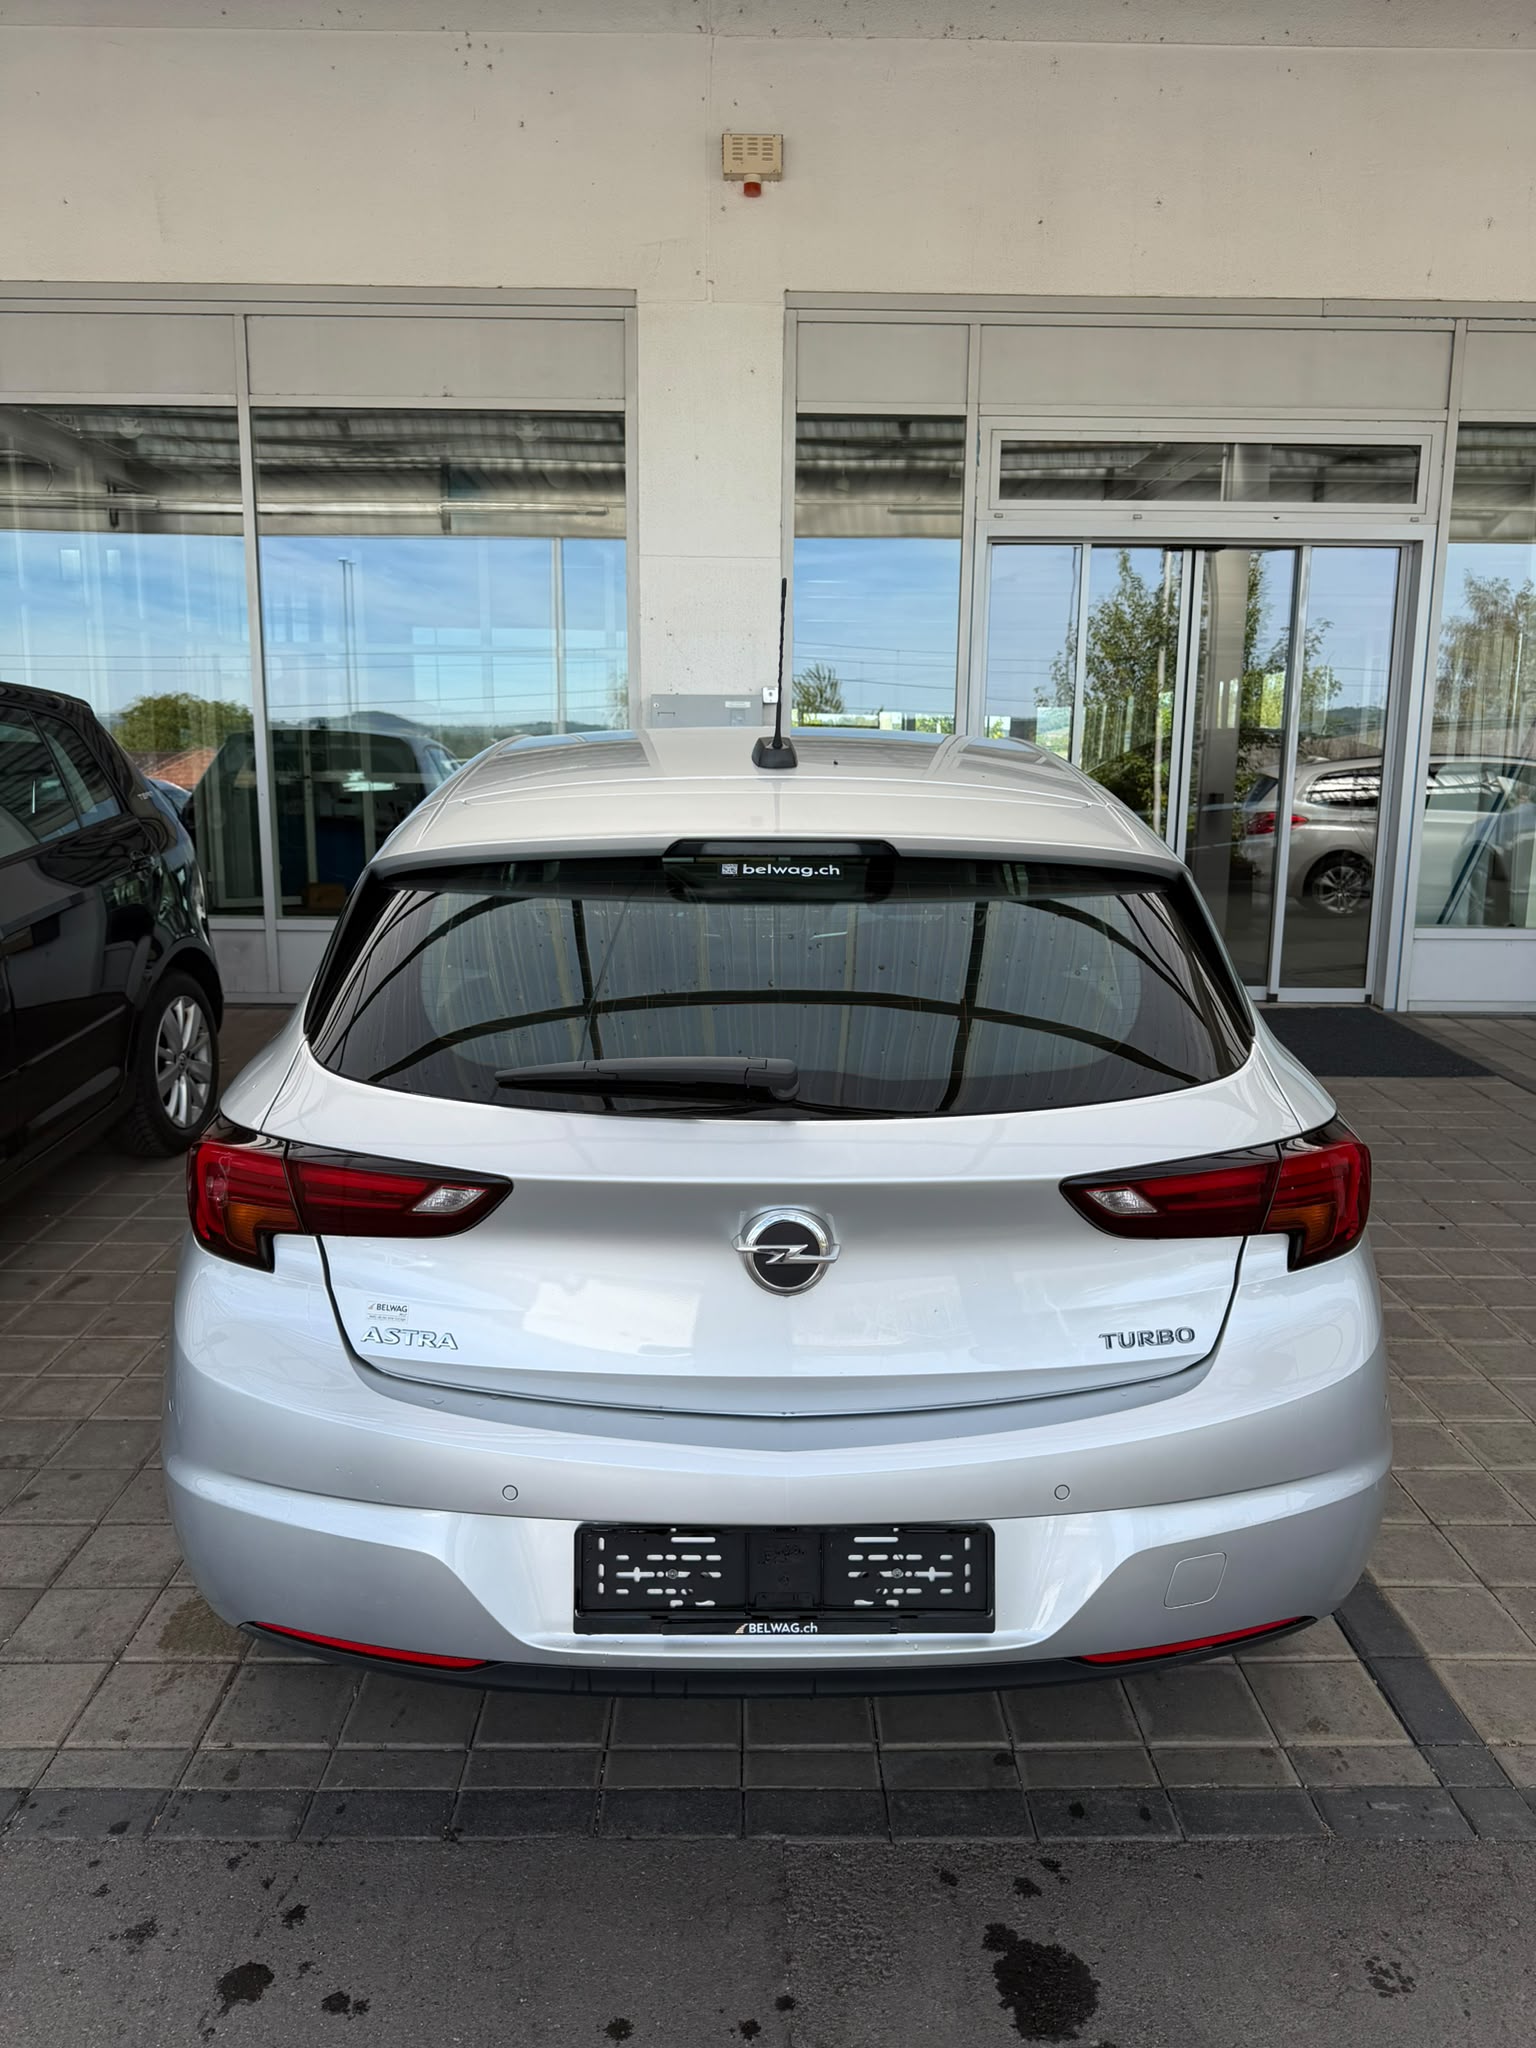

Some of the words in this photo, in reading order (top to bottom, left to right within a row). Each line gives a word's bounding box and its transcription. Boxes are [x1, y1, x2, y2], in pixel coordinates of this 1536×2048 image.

[743, 864, 840, 877] belwag.ch
[376, 1303, 408, 1313] BELWAG
[360, 1326, 459, 1350] ASTRA
[1098, 1327, 1195, 1349] TURBO
[748, 1622, 818, 1634] BELWAG.ch
